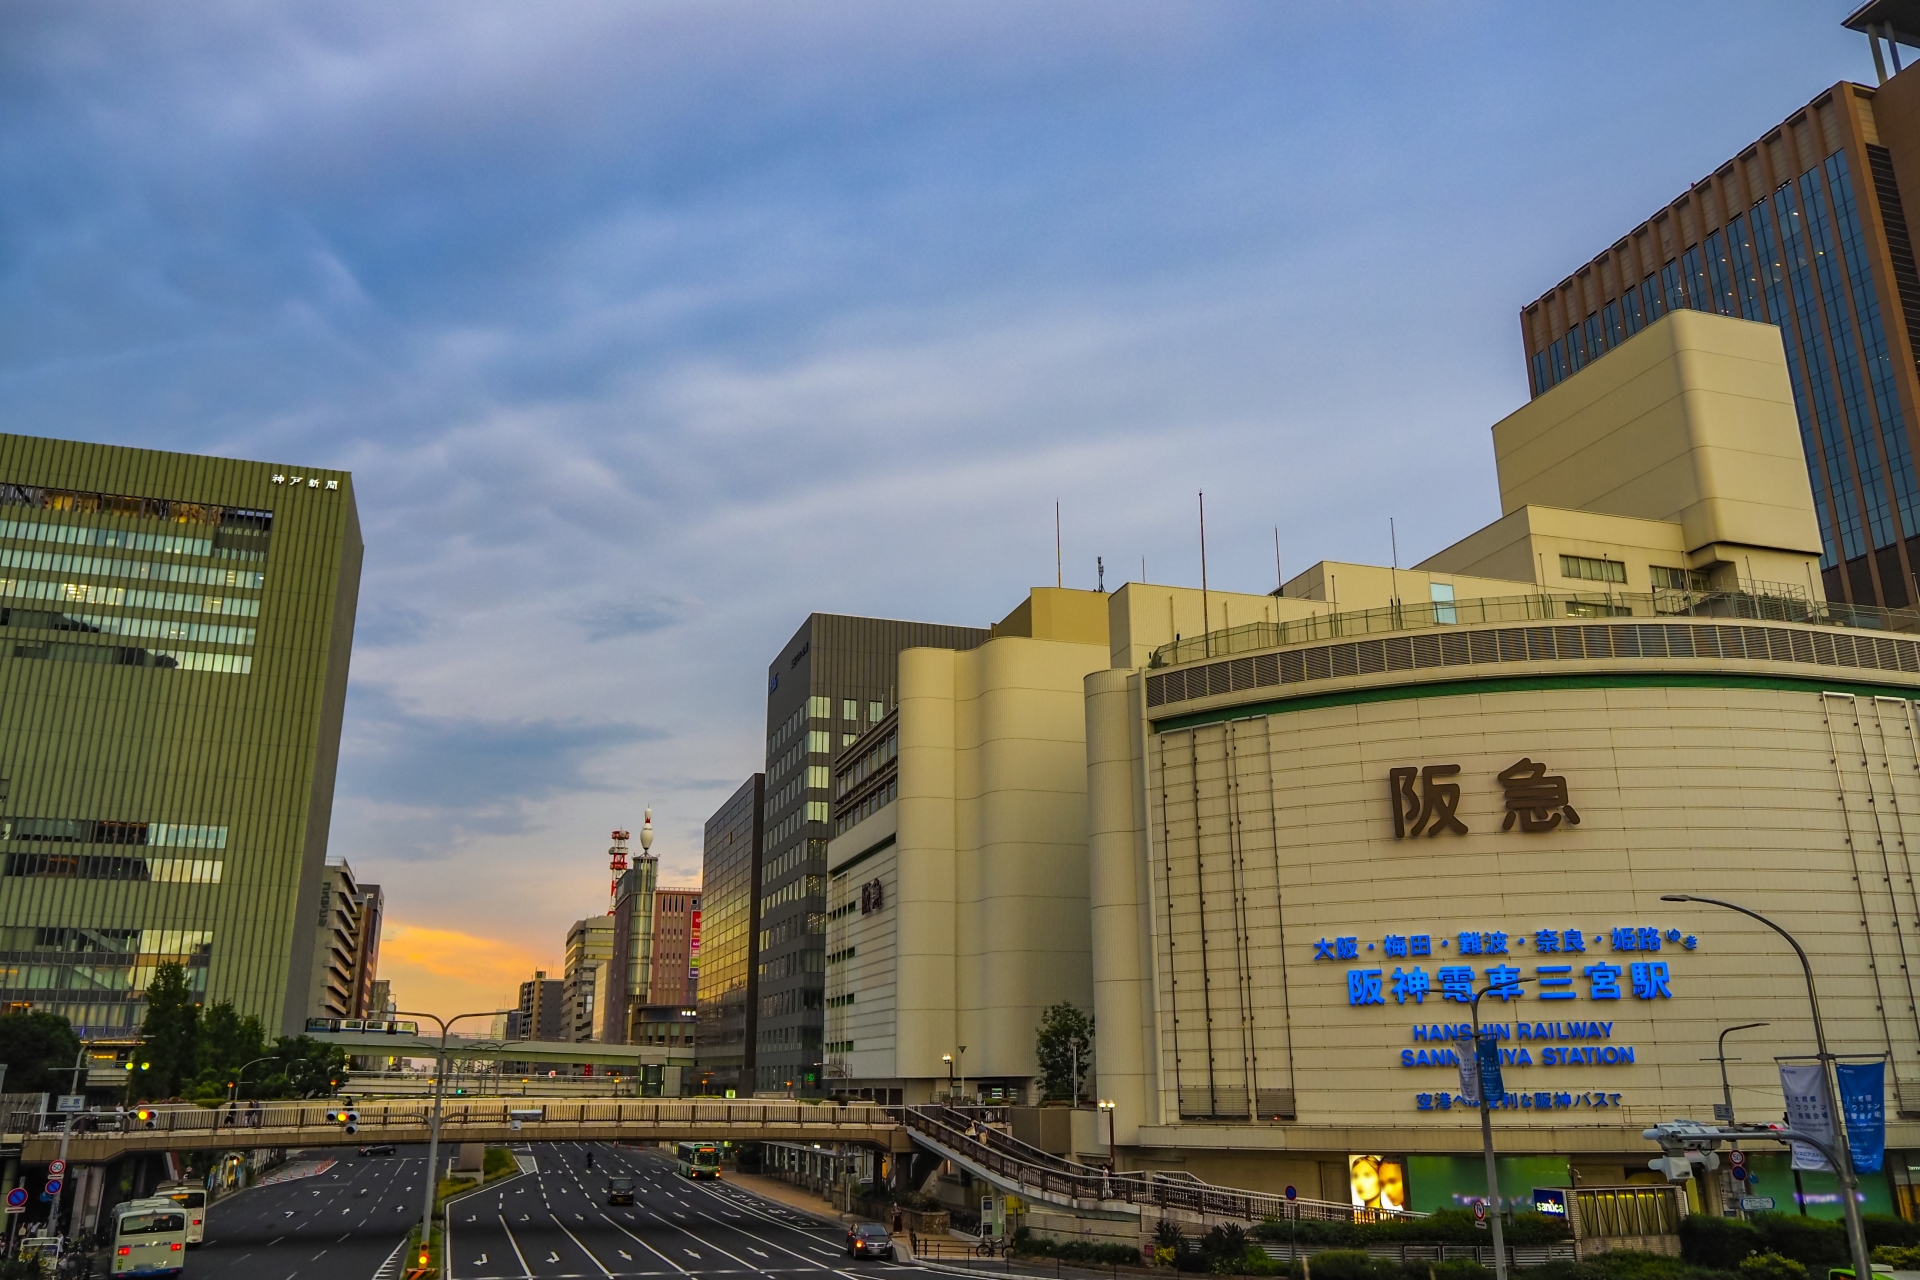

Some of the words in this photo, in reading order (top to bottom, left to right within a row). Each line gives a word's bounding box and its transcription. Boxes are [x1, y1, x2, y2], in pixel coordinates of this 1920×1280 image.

[1390, 758, 1580, 838] 阪急
[1347, 961, 1672, 1005] 阪神電車三宮駅
[1517, 1021, 1614, 1040] RAILWAY
[1401, 1047, 1533, 1067] SANNIYA
[1541, 1046, 1635, 1065] STATION
[1732, 1153, 1741, 1161] 50
